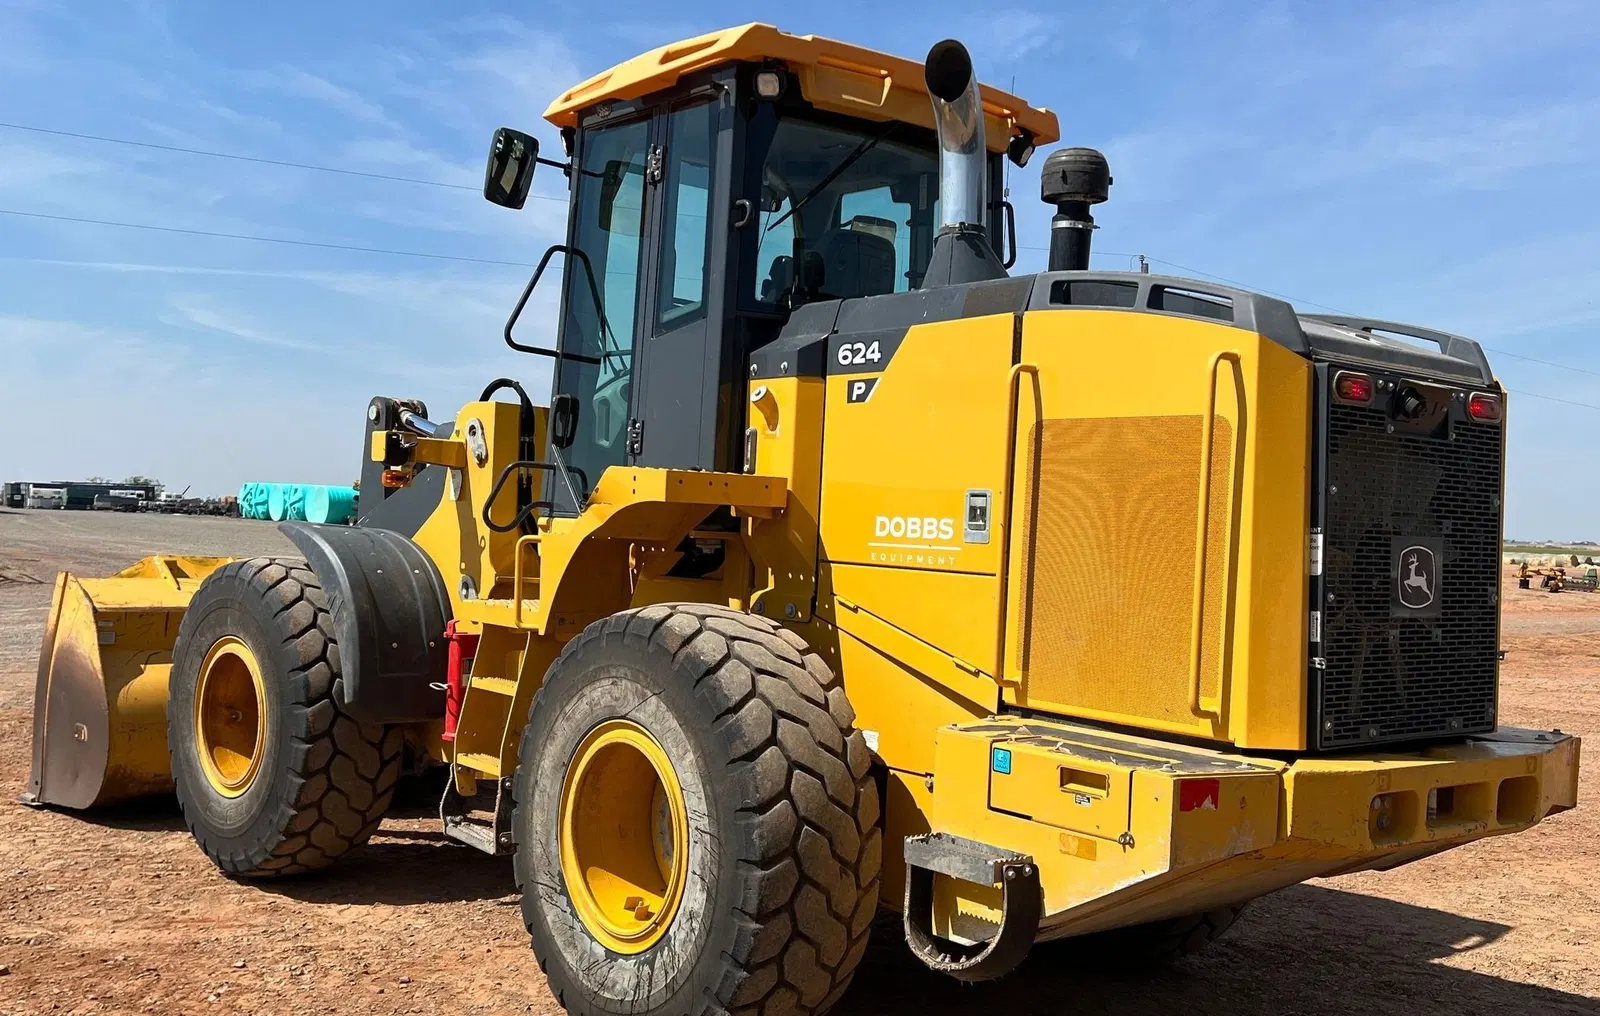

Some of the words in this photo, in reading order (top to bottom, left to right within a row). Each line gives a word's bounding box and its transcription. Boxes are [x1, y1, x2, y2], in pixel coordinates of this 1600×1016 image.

[838, 341, 882, 366] 624
[852, 381, 866, 401] P
[875, 516, 954, 540] DOBBS
[871, 552, 955, 566] EQUIPMENT
